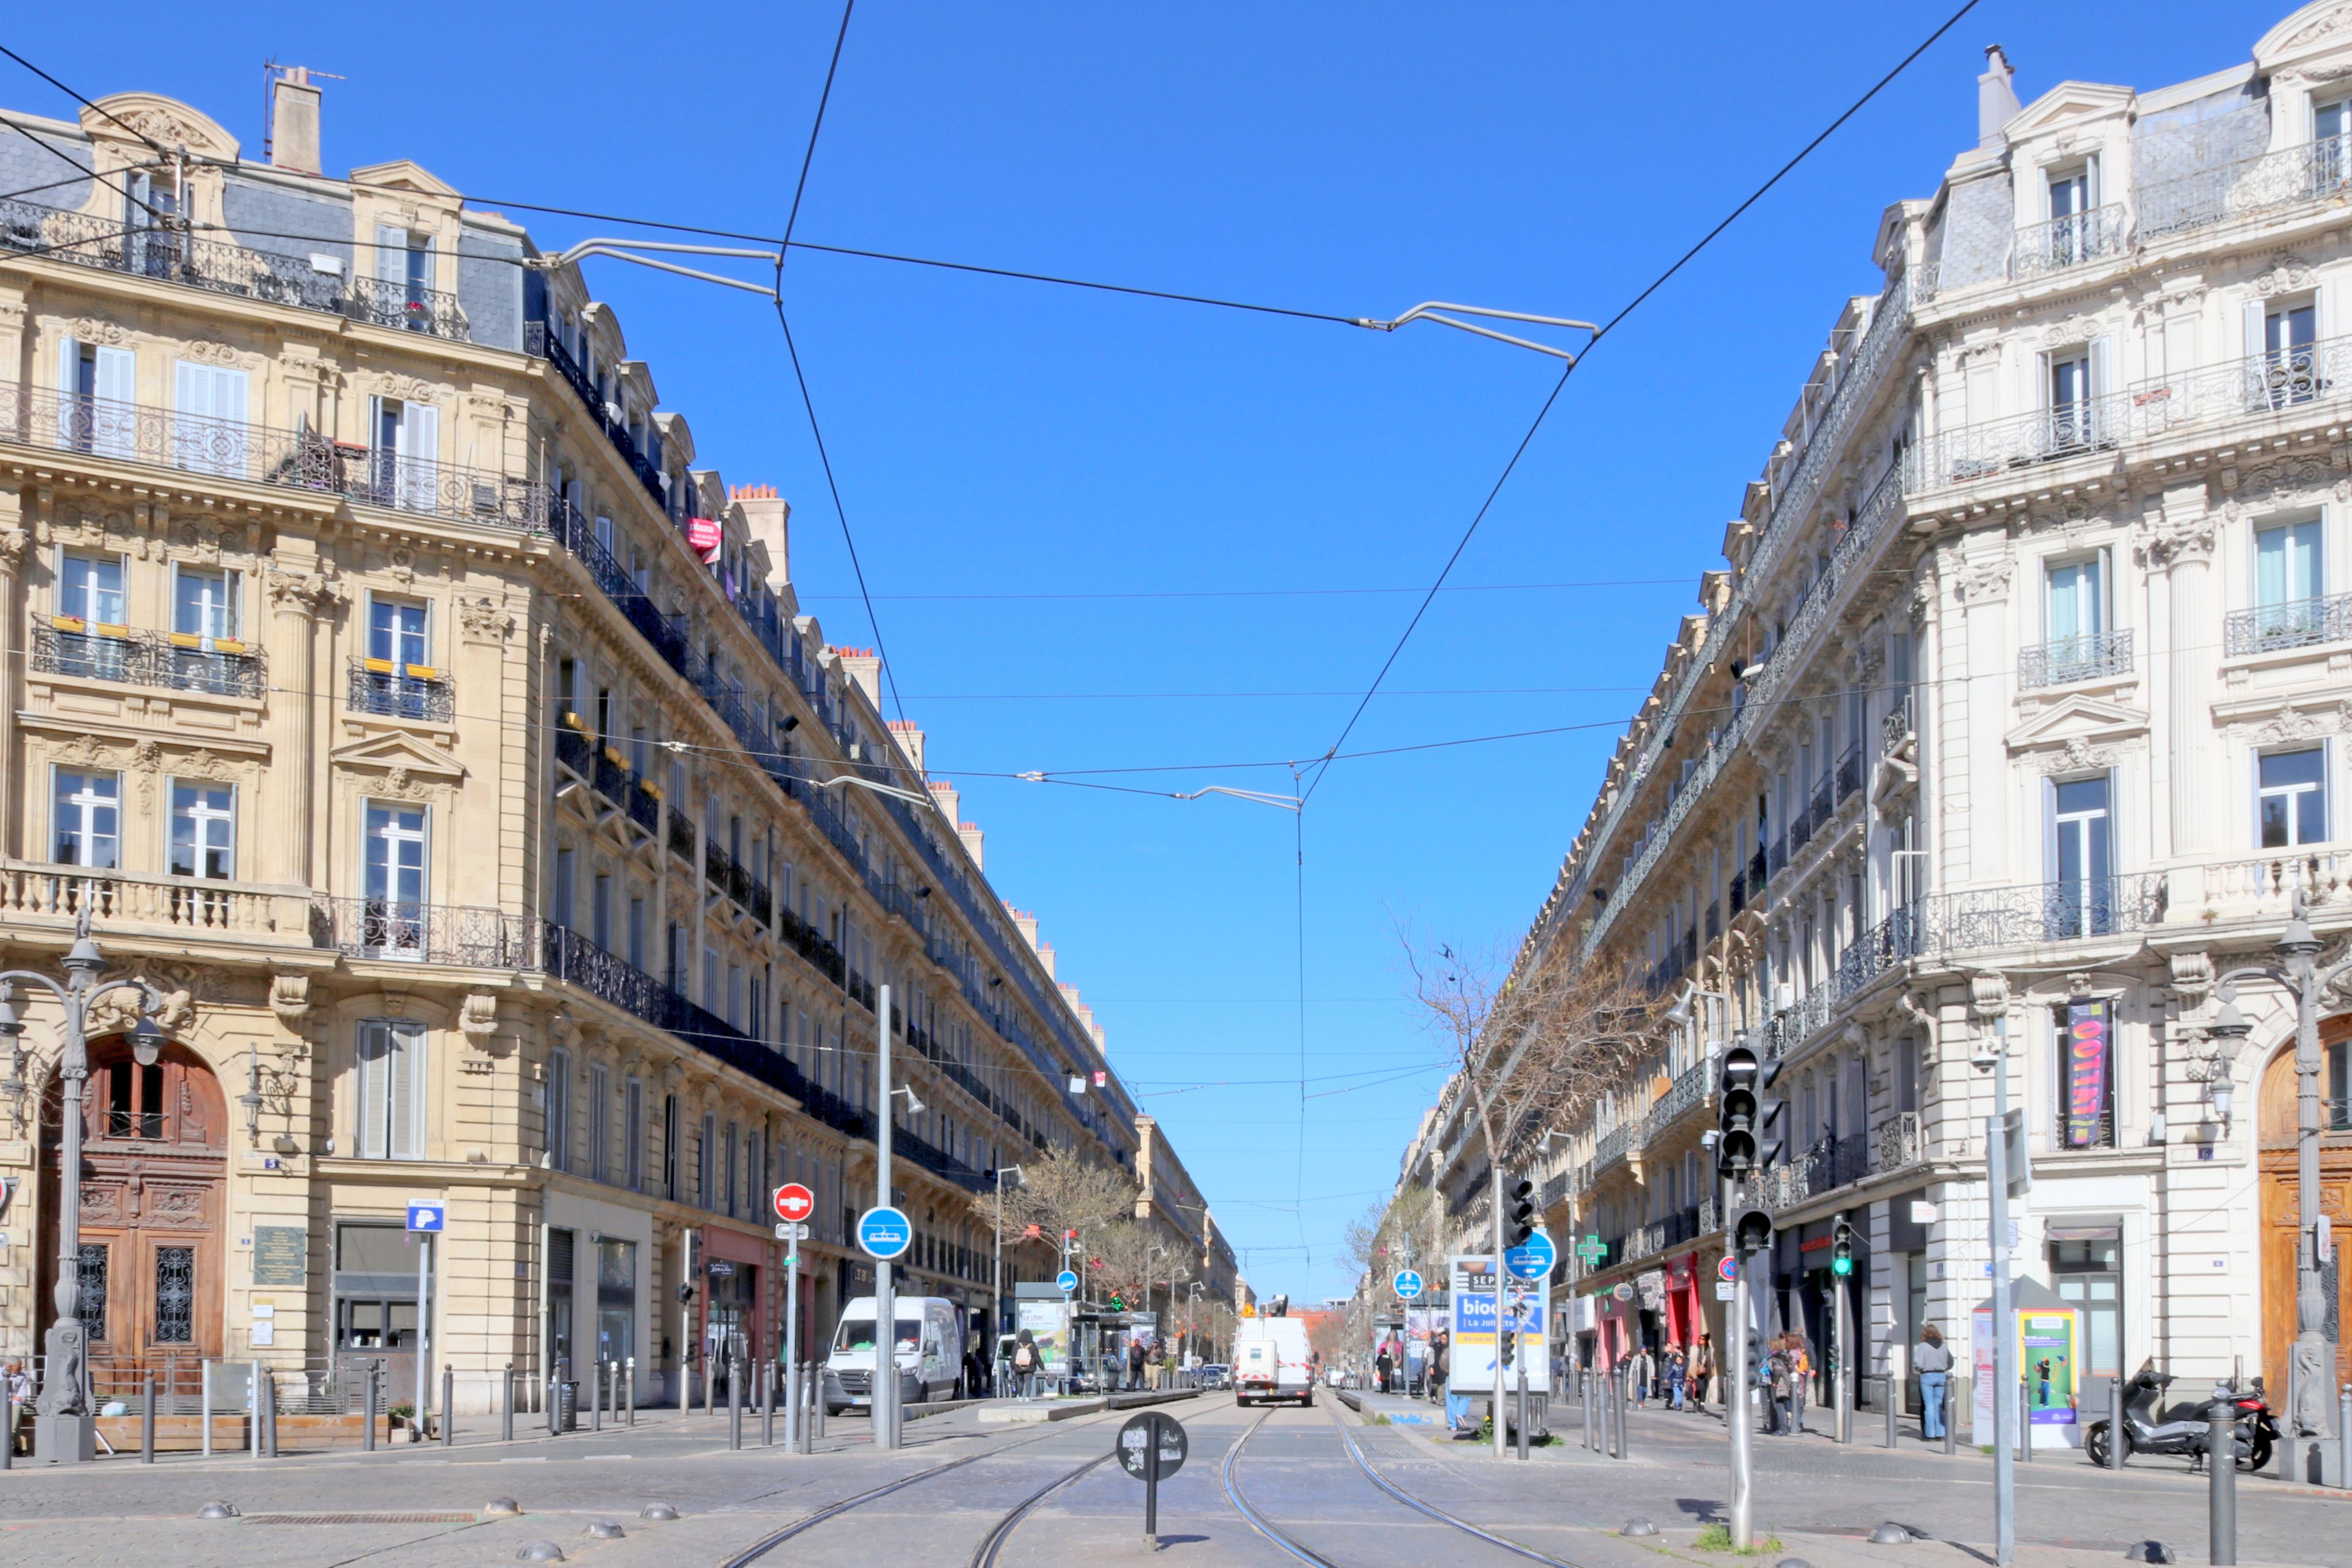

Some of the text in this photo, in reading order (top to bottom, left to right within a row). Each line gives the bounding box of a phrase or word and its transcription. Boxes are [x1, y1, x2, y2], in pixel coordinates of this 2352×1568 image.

[690, 522, 713, 533] plaza
[2202, 1149, 2208, 1159] 6
[269, 1159, 276, 1168] 5
